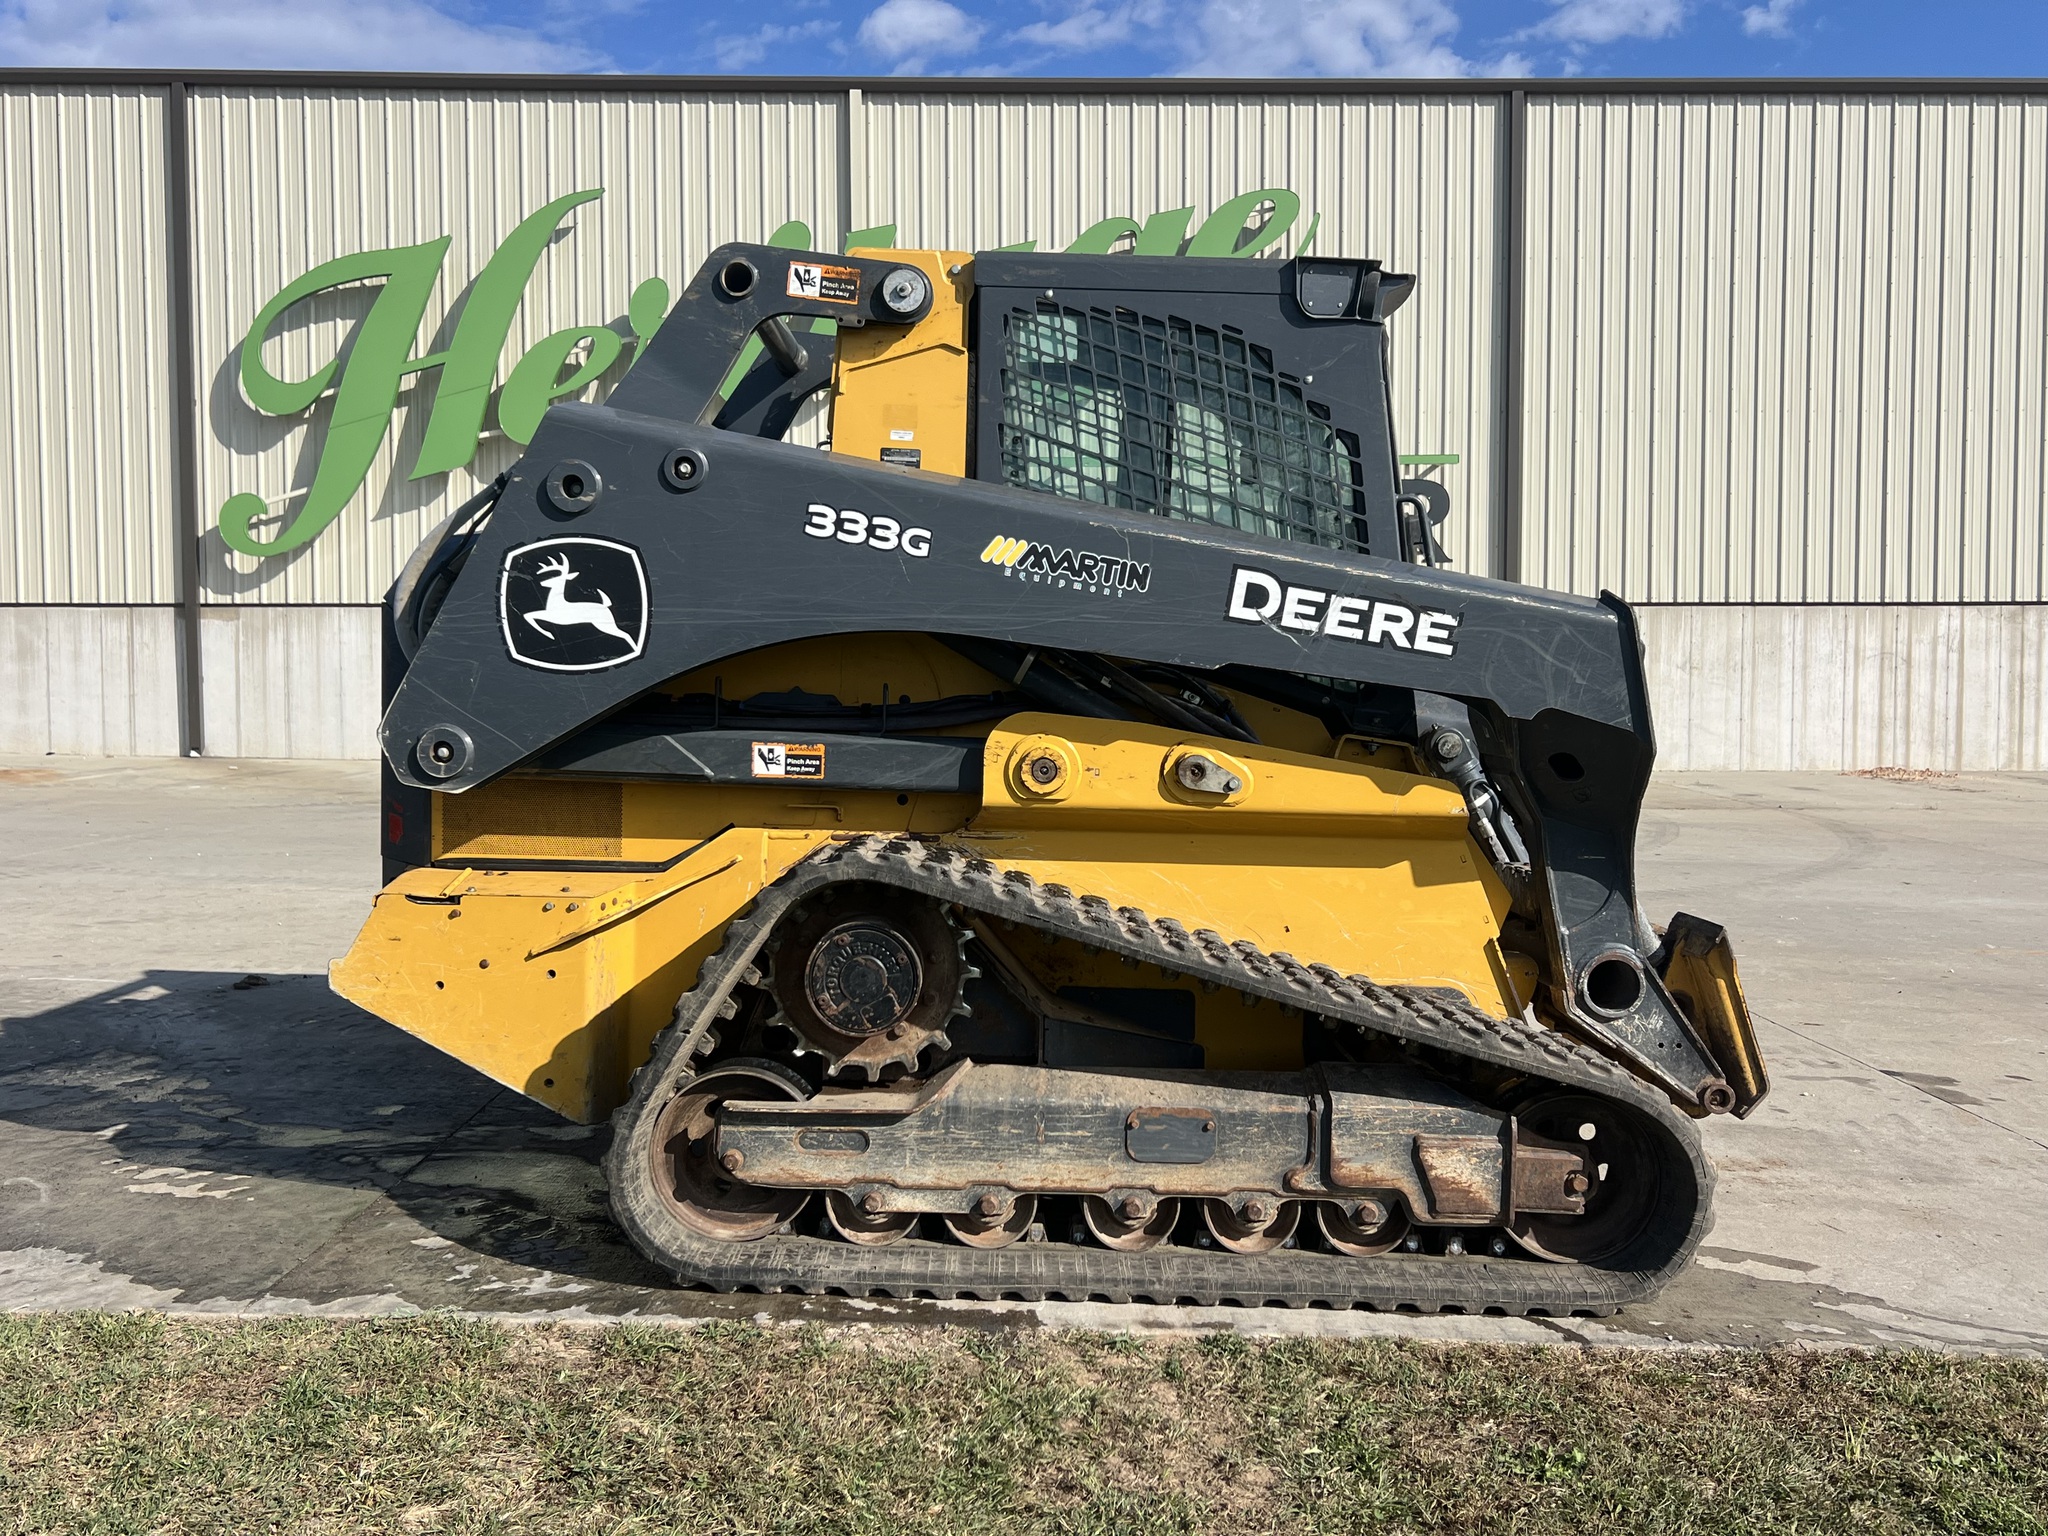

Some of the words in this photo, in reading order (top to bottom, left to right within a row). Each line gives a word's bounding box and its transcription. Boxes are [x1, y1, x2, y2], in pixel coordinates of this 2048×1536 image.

[835, 290, 850, 298] Away
[804, 503, 933, 559] 333G
[1004, 567, 1123, 598] Equipment
[1016, 541, 1152, 593] MARTIN
[1228, 568, 1459, 656] DEERE
[786, 757, 805, 765] Pinch
[805, 758, 820, 766] Area
[786, 765, 800, 773] Keep
